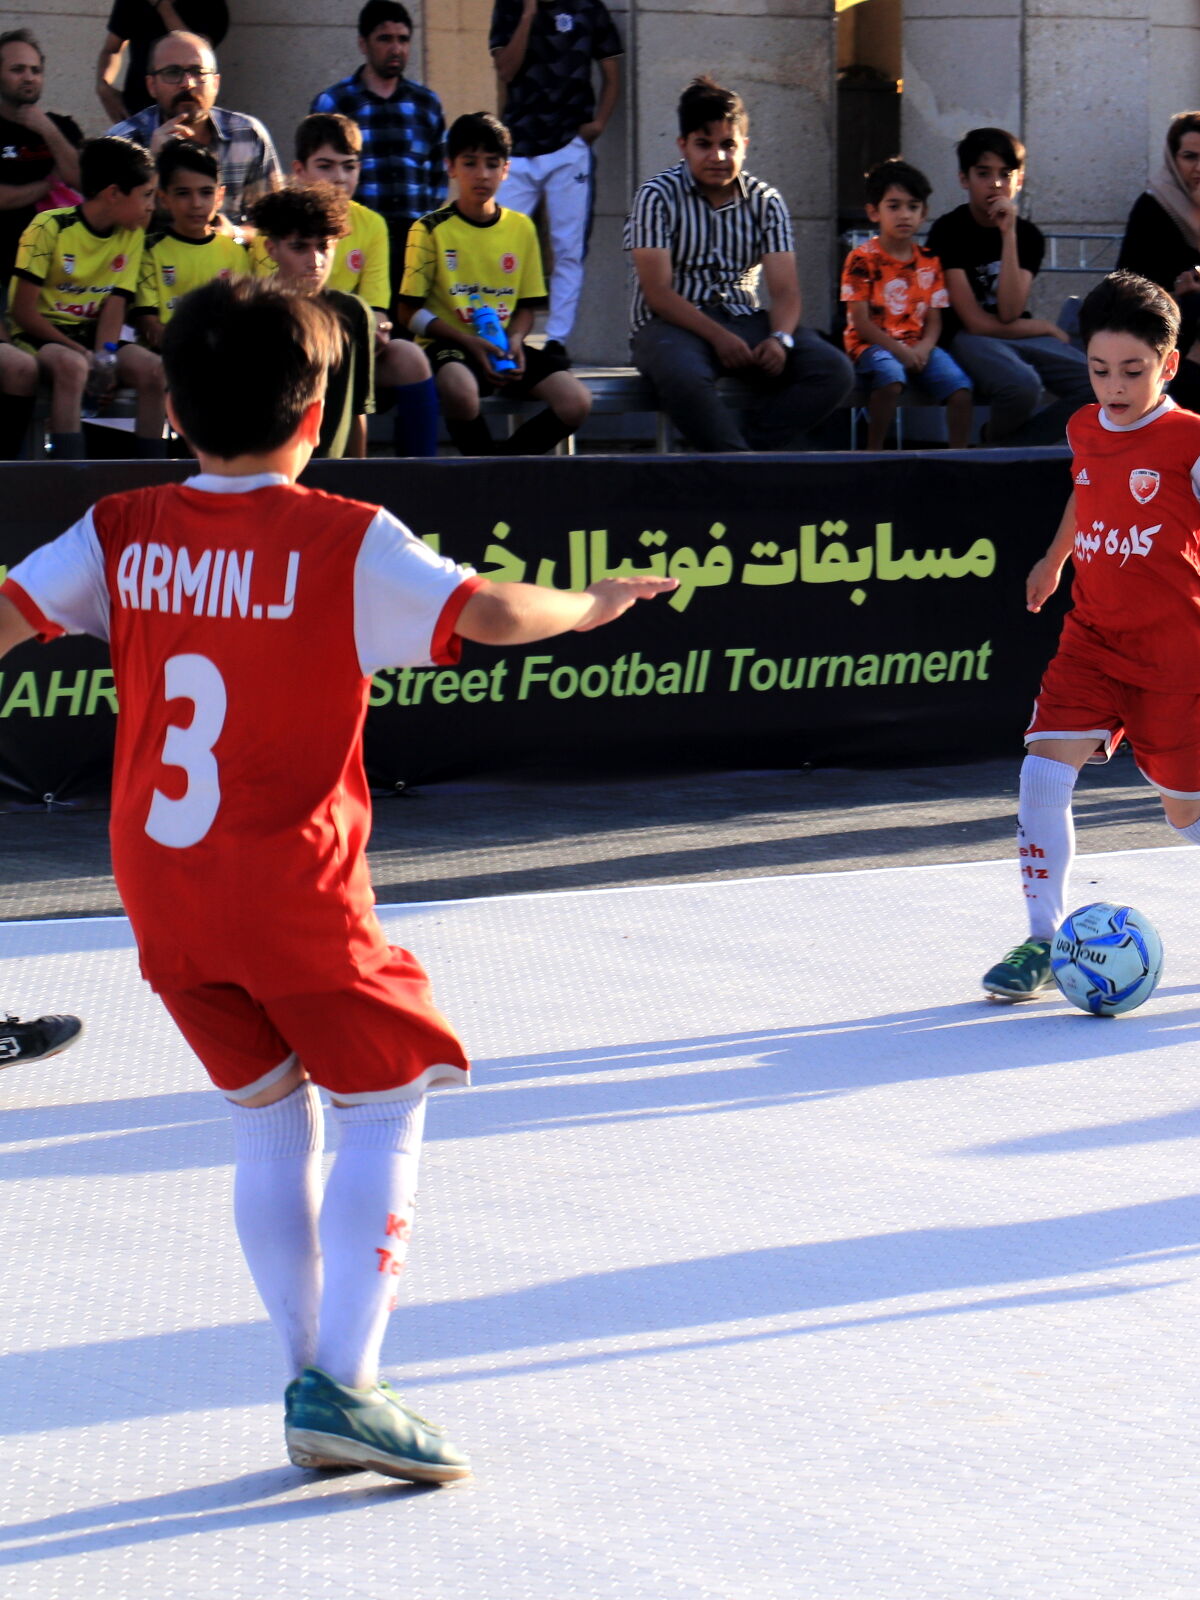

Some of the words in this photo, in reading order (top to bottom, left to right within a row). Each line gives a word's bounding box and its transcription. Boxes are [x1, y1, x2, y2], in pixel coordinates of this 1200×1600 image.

[117, 542, 300, 620] ARMIN.J
[741, 519, 996, 606] مسابقات
[0, 669, 120, 718] AHR
[368, 658, 508, 707] Street
[517, 649, 711, 701] Football
[724, 639, 993, 692] Tournament
[144, 653, 228, 849] 3
[1056, 938, 1107, 966] molten
